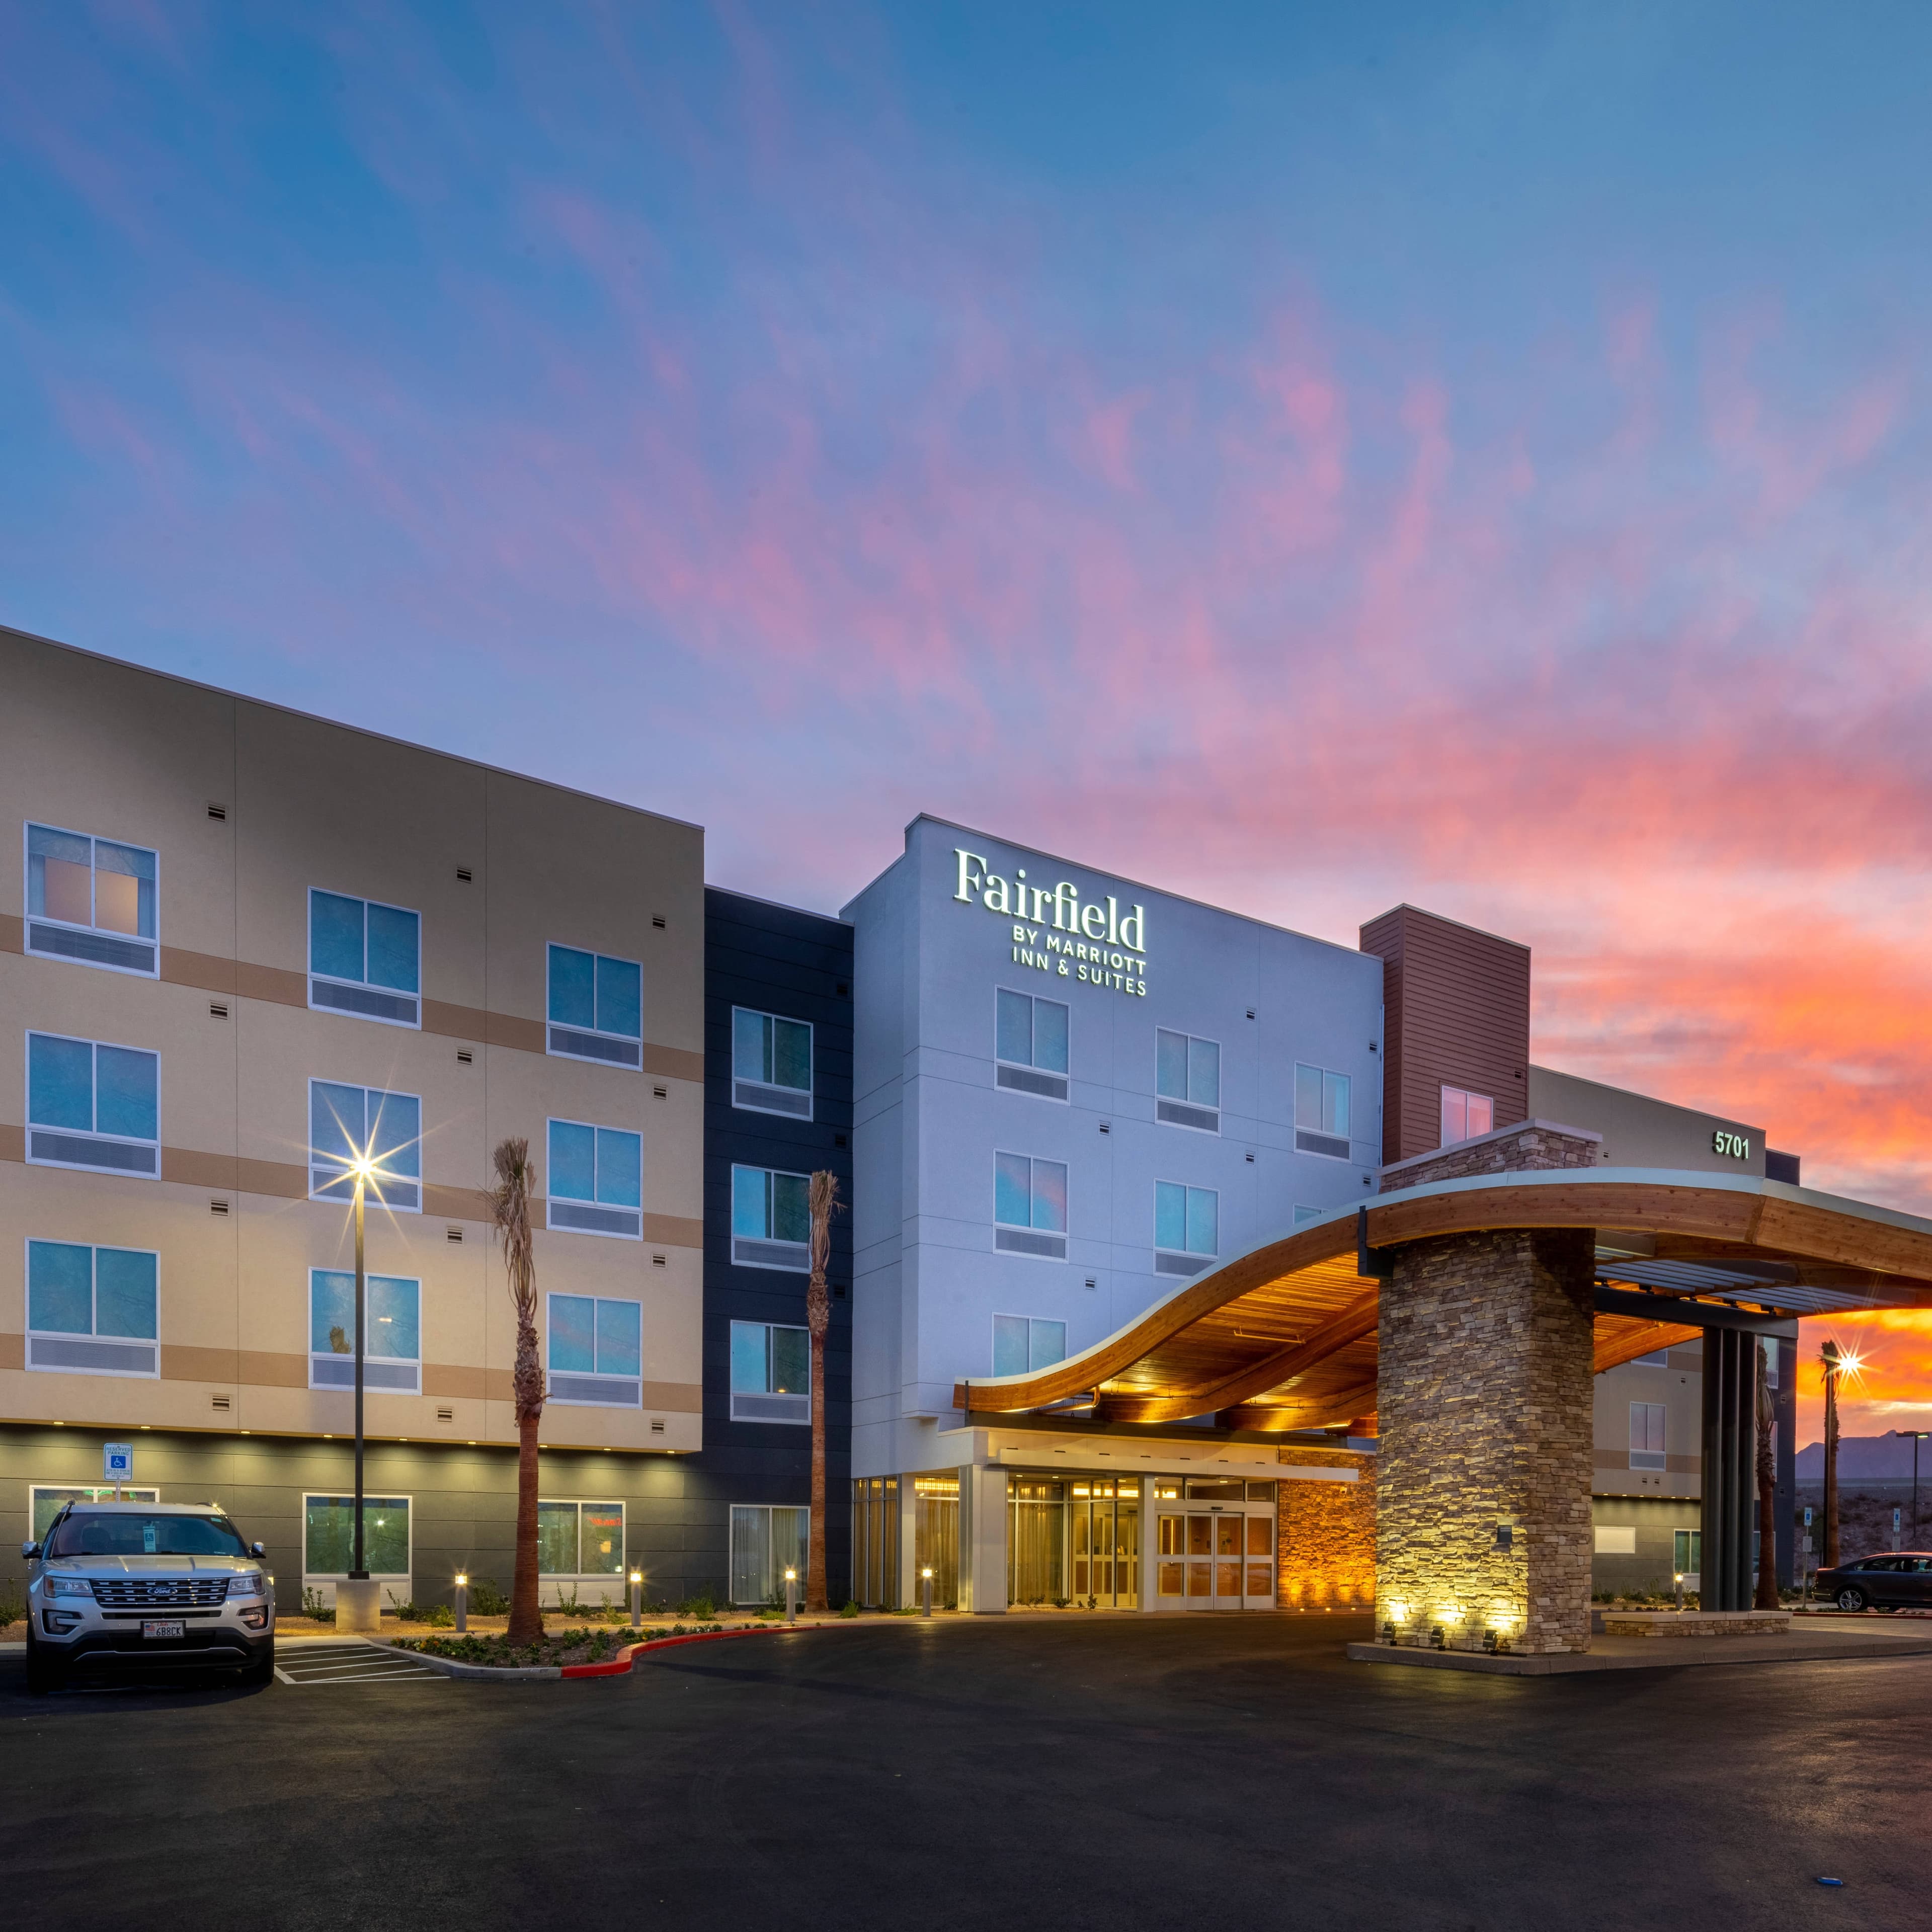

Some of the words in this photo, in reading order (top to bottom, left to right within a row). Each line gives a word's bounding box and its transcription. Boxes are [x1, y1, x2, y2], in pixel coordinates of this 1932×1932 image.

[953, 848, 1146, 953] Fairfield
[1012, 925, 1037, 945] BY
[1046, 934, 1146, 975] MARRIOTT
[1012, 946, 1048, 970] INN
[1058, 959, 1069, 976] &
[1077, 964, 1146, 996] SUITES
[1715, 1131, 1749, 1159] 5701
[156, 1627, 181, 1636] 6B8CK
